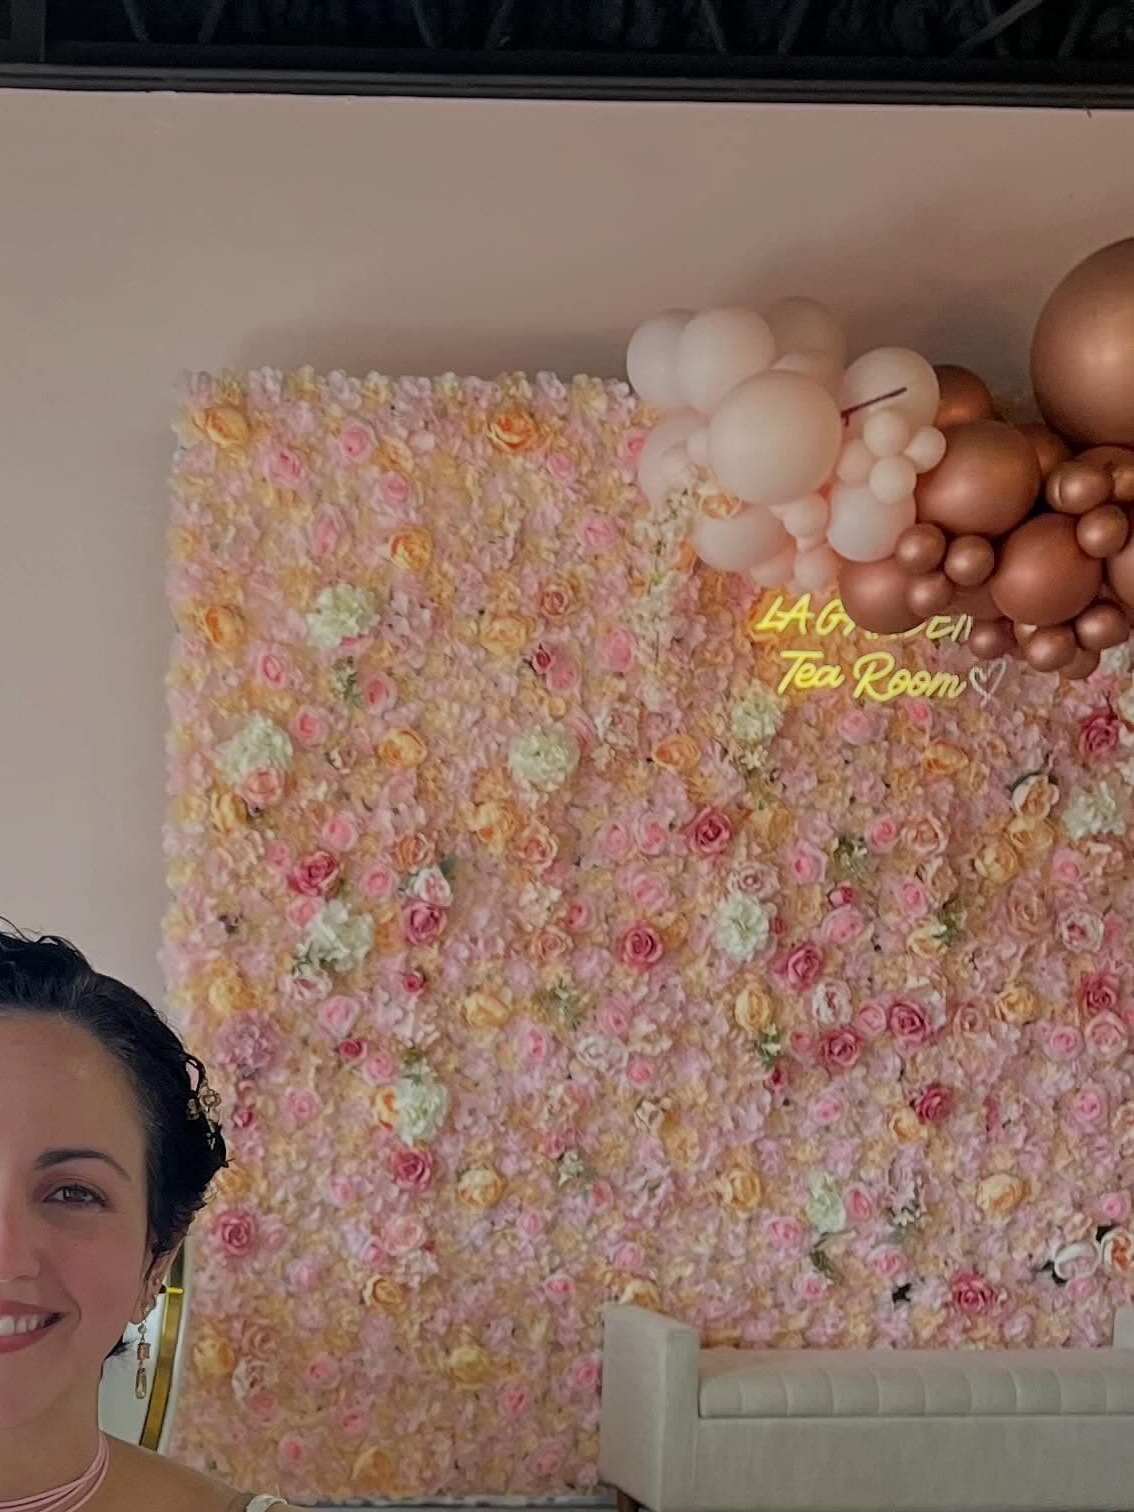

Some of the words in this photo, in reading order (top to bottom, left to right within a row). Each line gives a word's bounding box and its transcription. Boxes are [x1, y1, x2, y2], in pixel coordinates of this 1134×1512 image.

[754, 592, 815, 635] LA
[778, 650, 845, 695] Tea
[852, 651, 967, 702] Room
